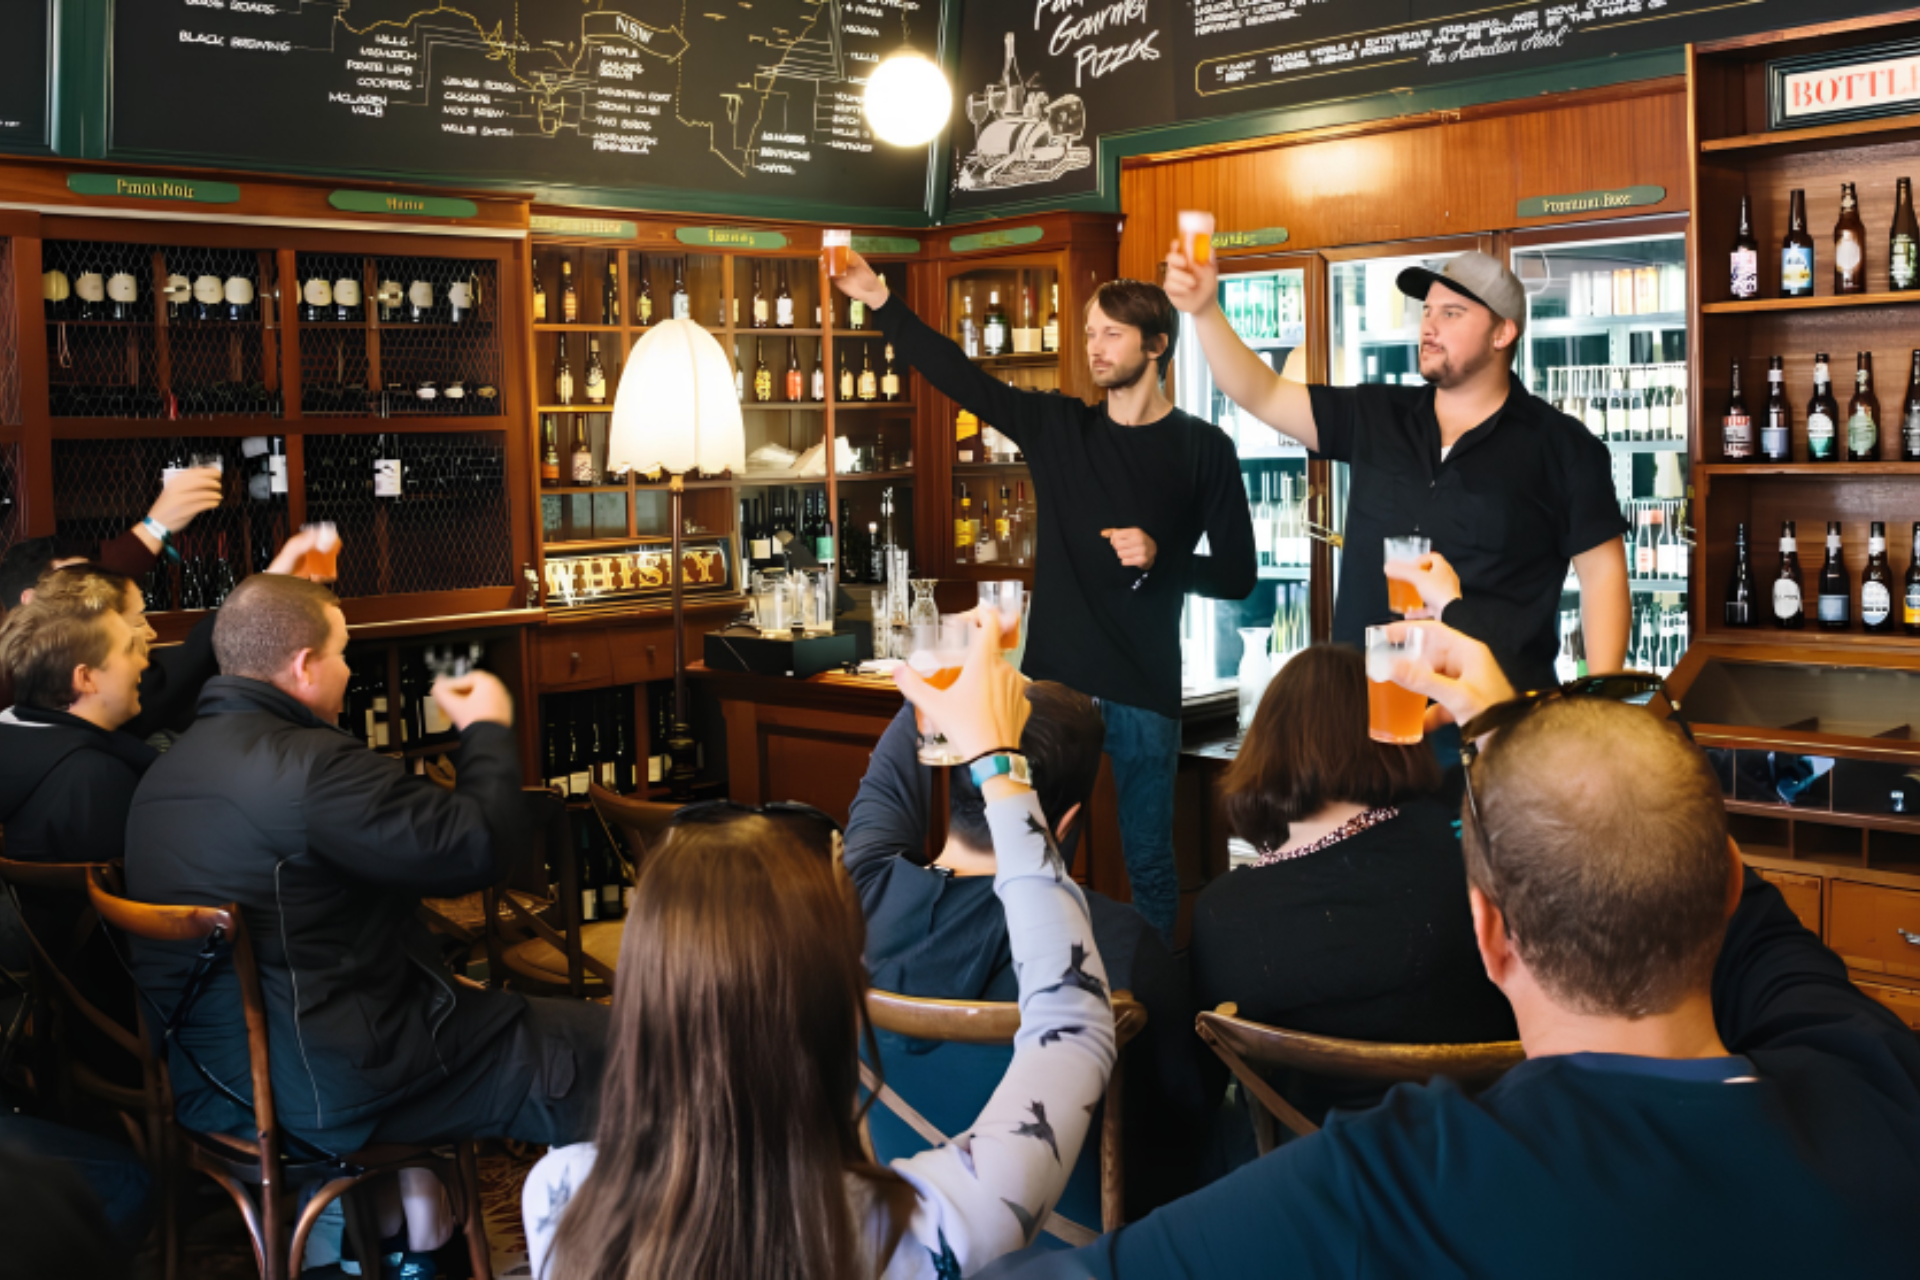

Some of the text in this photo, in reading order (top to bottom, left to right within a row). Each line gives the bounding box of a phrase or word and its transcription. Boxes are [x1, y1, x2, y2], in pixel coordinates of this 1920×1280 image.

[179, 30, 224, 46] BLACK
[615, 16, 653, 44] NSW
[1074, 30, 1161, 88] Pizzas
[163, 181, 195, 198] Noir
[545, 551, 713, 595] WHISKY
